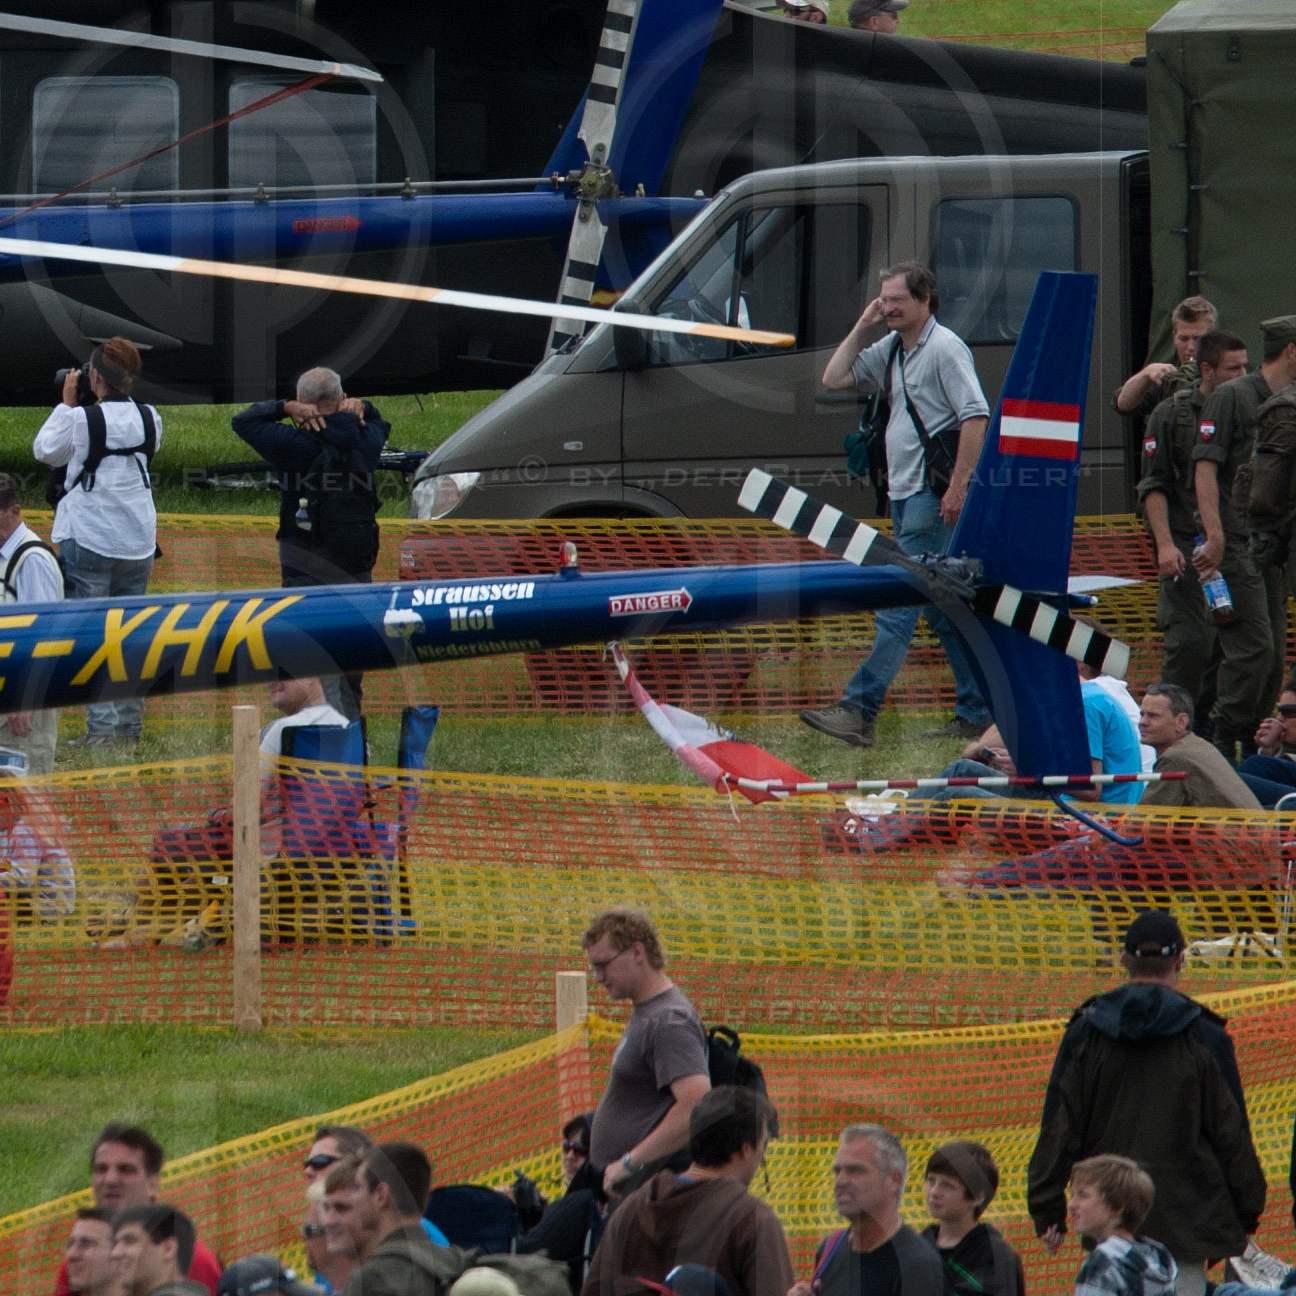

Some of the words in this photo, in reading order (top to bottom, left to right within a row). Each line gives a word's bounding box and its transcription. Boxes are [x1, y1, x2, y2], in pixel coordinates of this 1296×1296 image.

[411, 581, 536, 606] Straussen
[611, 593, 682, 613] DANGER
[449, 604, 495, 632] Hof
